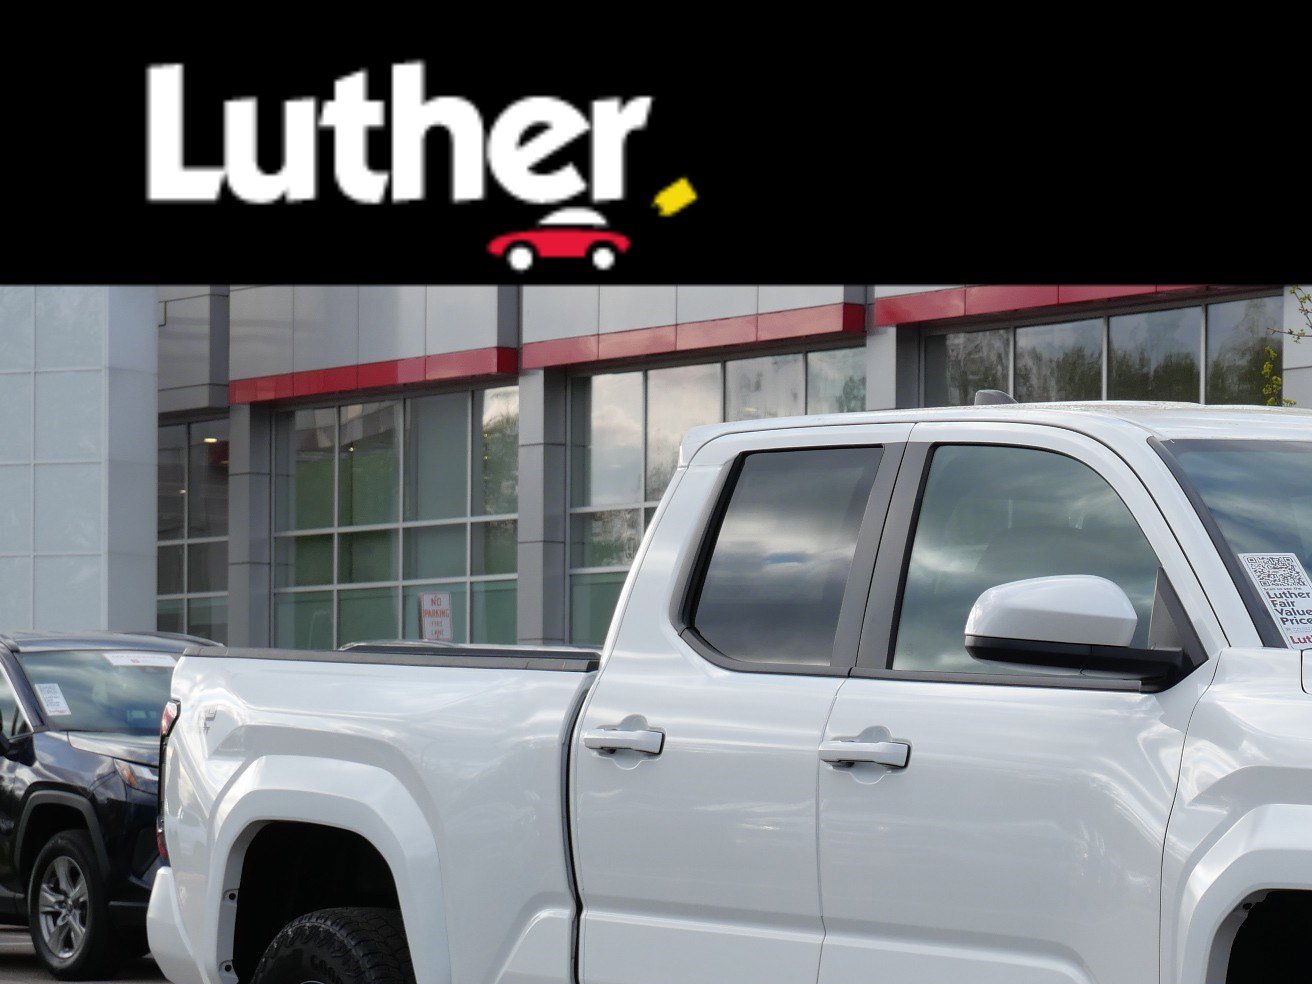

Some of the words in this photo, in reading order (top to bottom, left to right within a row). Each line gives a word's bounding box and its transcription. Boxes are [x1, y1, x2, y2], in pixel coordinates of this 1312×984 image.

[1266, 591, 1310, 599] Luther
[431, 598, 442, 607] NO
[1270, 600, 1295, 608] Fair
[423, 608, 449, 618] PARKING
